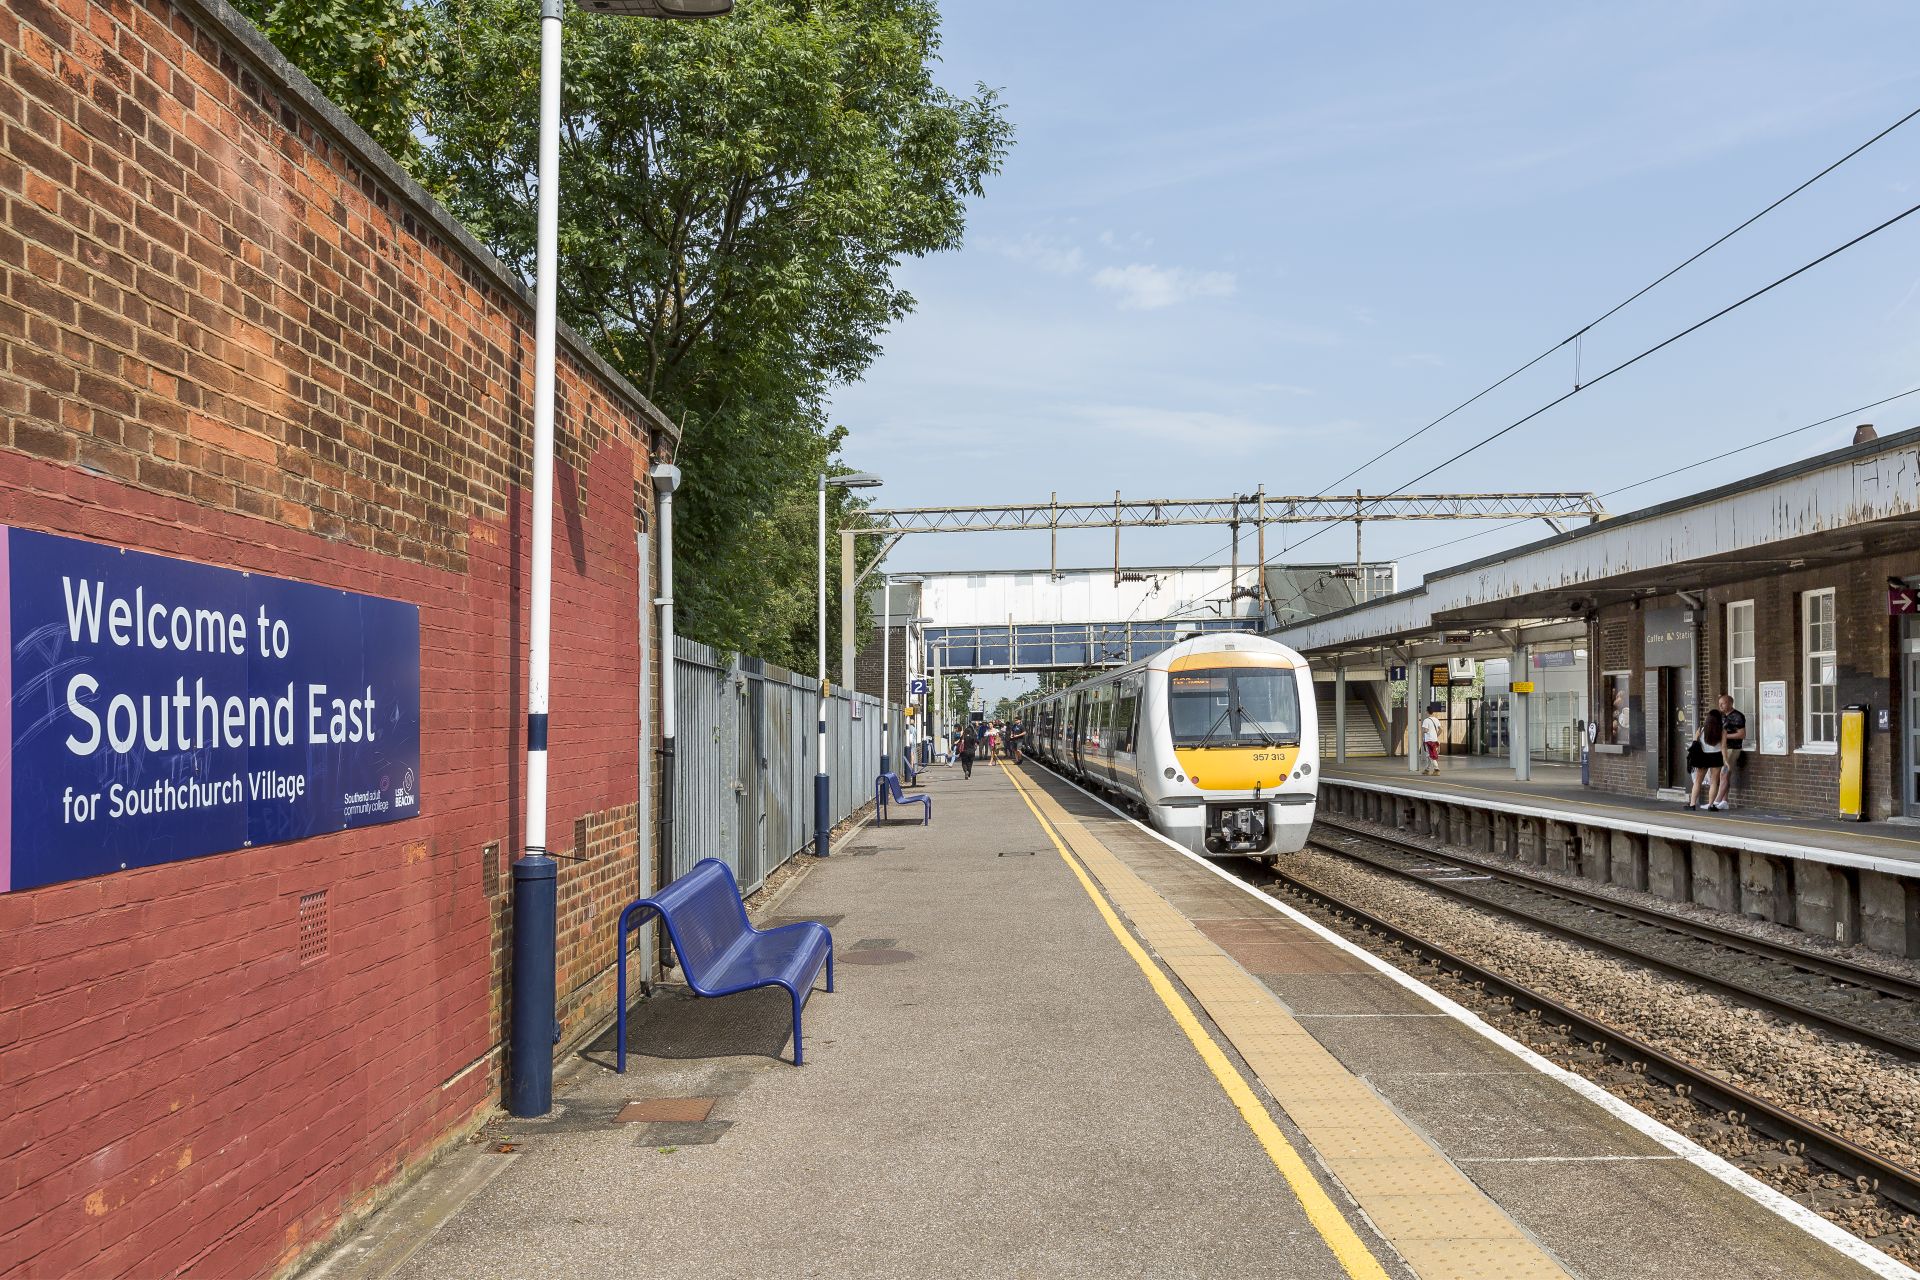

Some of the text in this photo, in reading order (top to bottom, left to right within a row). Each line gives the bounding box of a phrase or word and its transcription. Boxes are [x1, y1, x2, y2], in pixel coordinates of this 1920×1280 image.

[62, 575, 290, 659] Welcome to
[1395, 667, 1401, 680] 1
[914, 681, 923, 693] 2
[65, 673, 376, 756] Southend East
[1253, 753, 1286, 761] 357 313
[62, 769, 305, 824] for Southchurch Village
[344, 789, 381, 805] Southend adult
[394, 795, 415, 808] BEACON
[343, 800, 389, 816] community college
